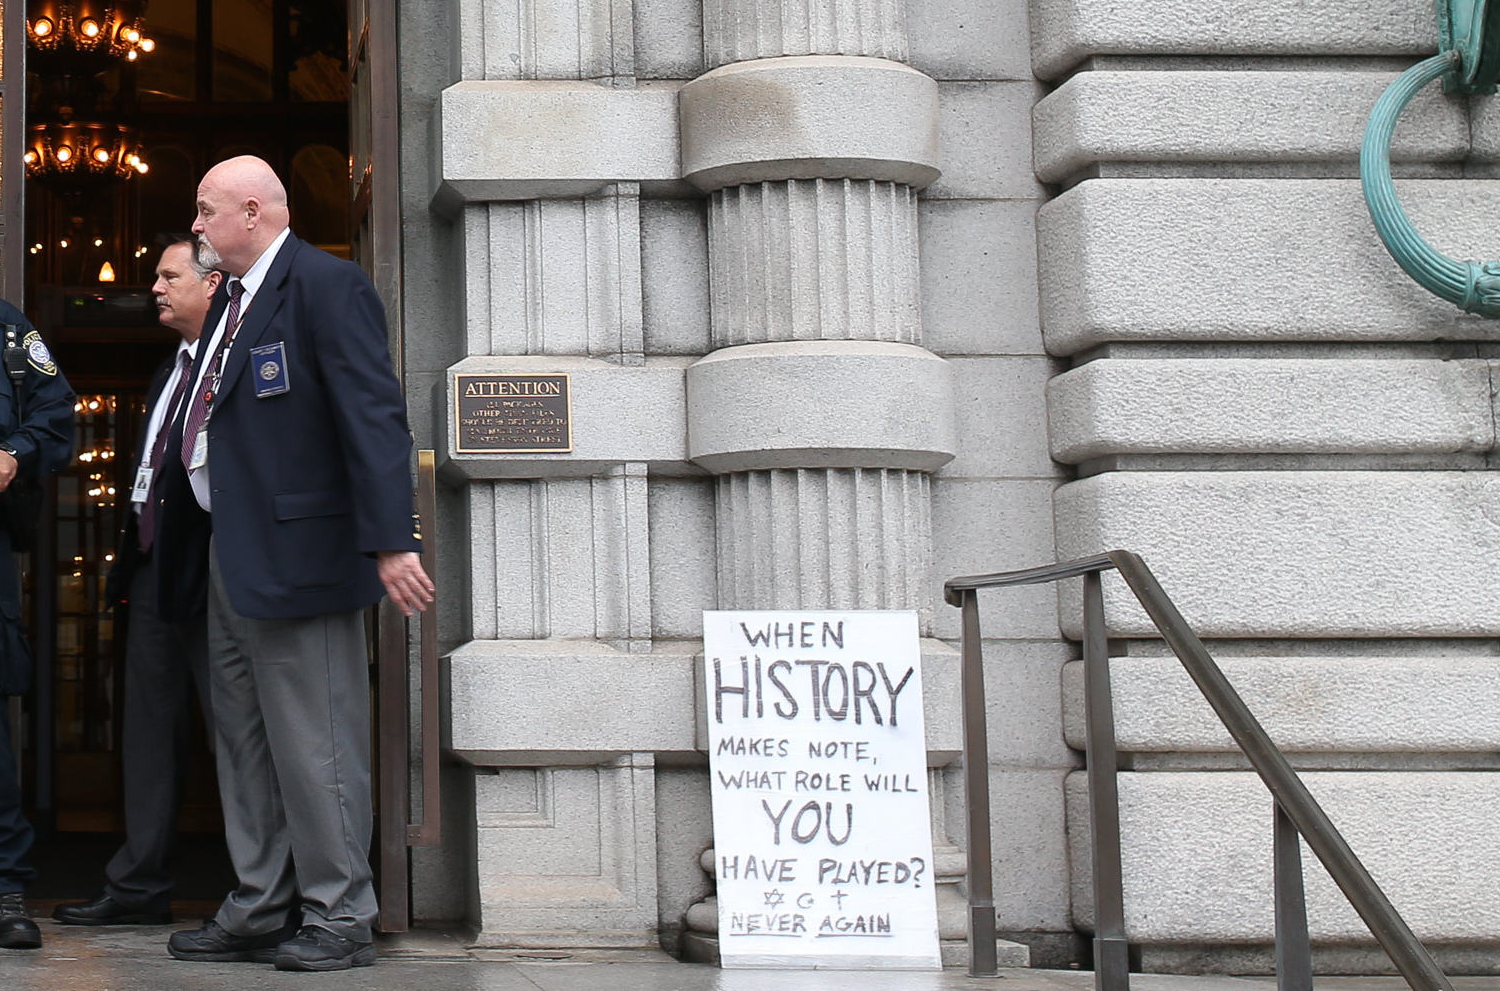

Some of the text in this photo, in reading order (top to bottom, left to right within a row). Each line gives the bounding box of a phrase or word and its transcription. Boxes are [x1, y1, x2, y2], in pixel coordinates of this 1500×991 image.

[464, 381, 561, 395] ATTENTION
[739, 620, 845, 650] WHEN
[712, 654, 914, 727] HISTORY
[716, 735, 878, 766] MAKES NOTE,
[717, 769, 919, 793] WHAT ROLE WILL
[761, 799, 853, 847] YOU
[721, 854, 926, 889] HAVE PLAYED?
[730, 911, 892, 934] NEVER AGAIN
